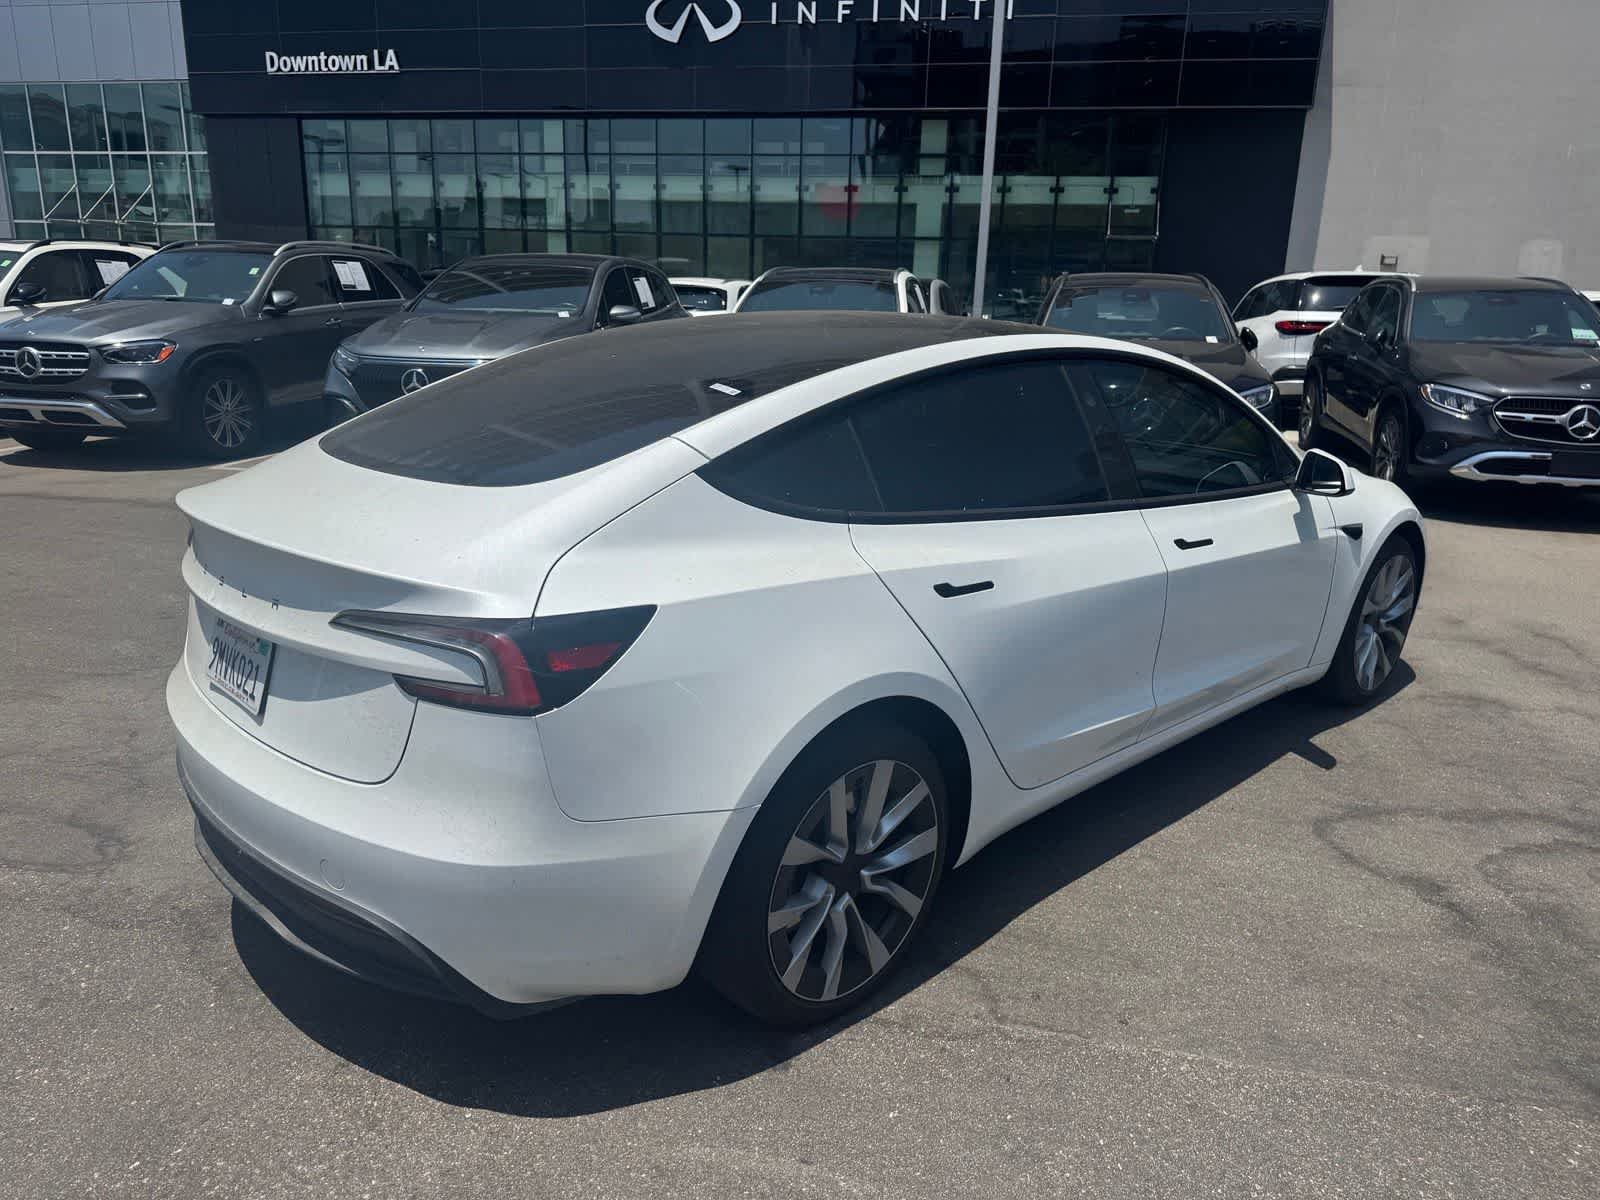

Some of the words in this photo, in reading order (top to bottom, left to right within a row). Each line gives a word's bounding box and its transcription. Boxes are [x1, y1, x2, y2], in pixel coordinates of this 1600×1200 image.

[771, 0, 1014, 24] INFINITI
[265, 51, 368, 73] Downtown
[373, 49, 400, 72] LA
[208, 637, 260, 701] 9MVK021
